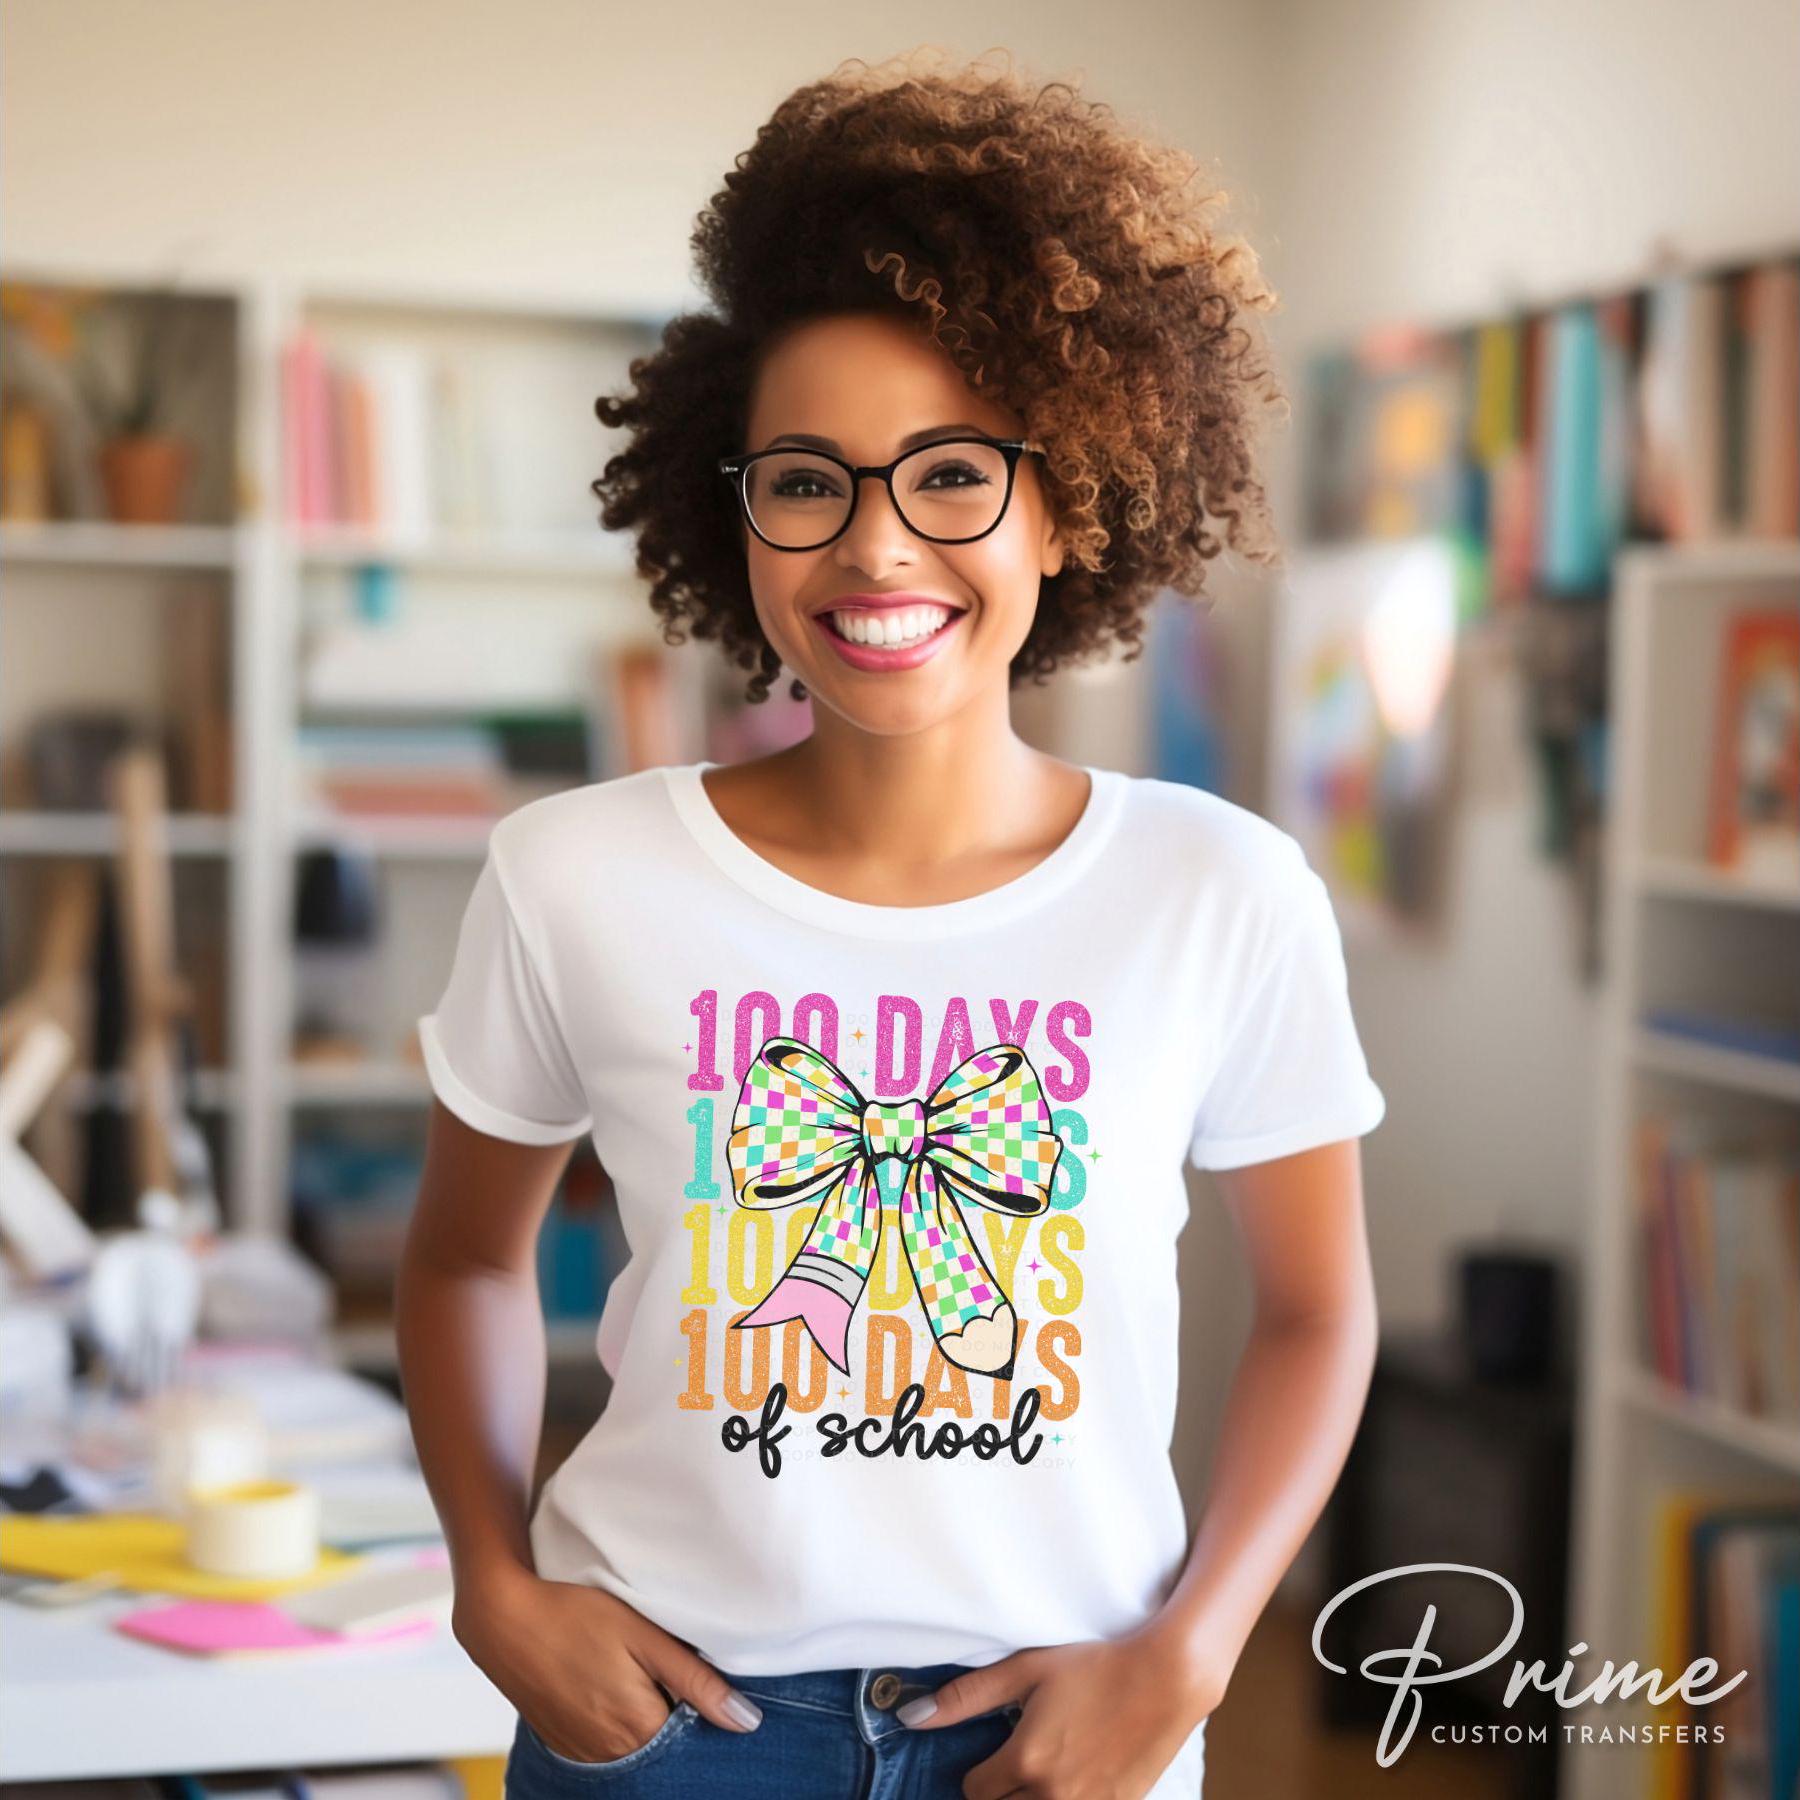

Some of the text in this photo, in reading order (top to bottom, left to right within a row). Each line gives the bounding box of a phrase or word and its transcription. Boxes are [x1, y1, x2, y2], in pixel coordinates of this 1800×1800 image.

[687, 989, 840, 1093] 100
[874, 994, 1092, 1103] DAYS
[866, 1208, 1086, 1317] DYS
[676, 1307, 831, 1414] 100
[721, 1382, 1044, 1479] of school
